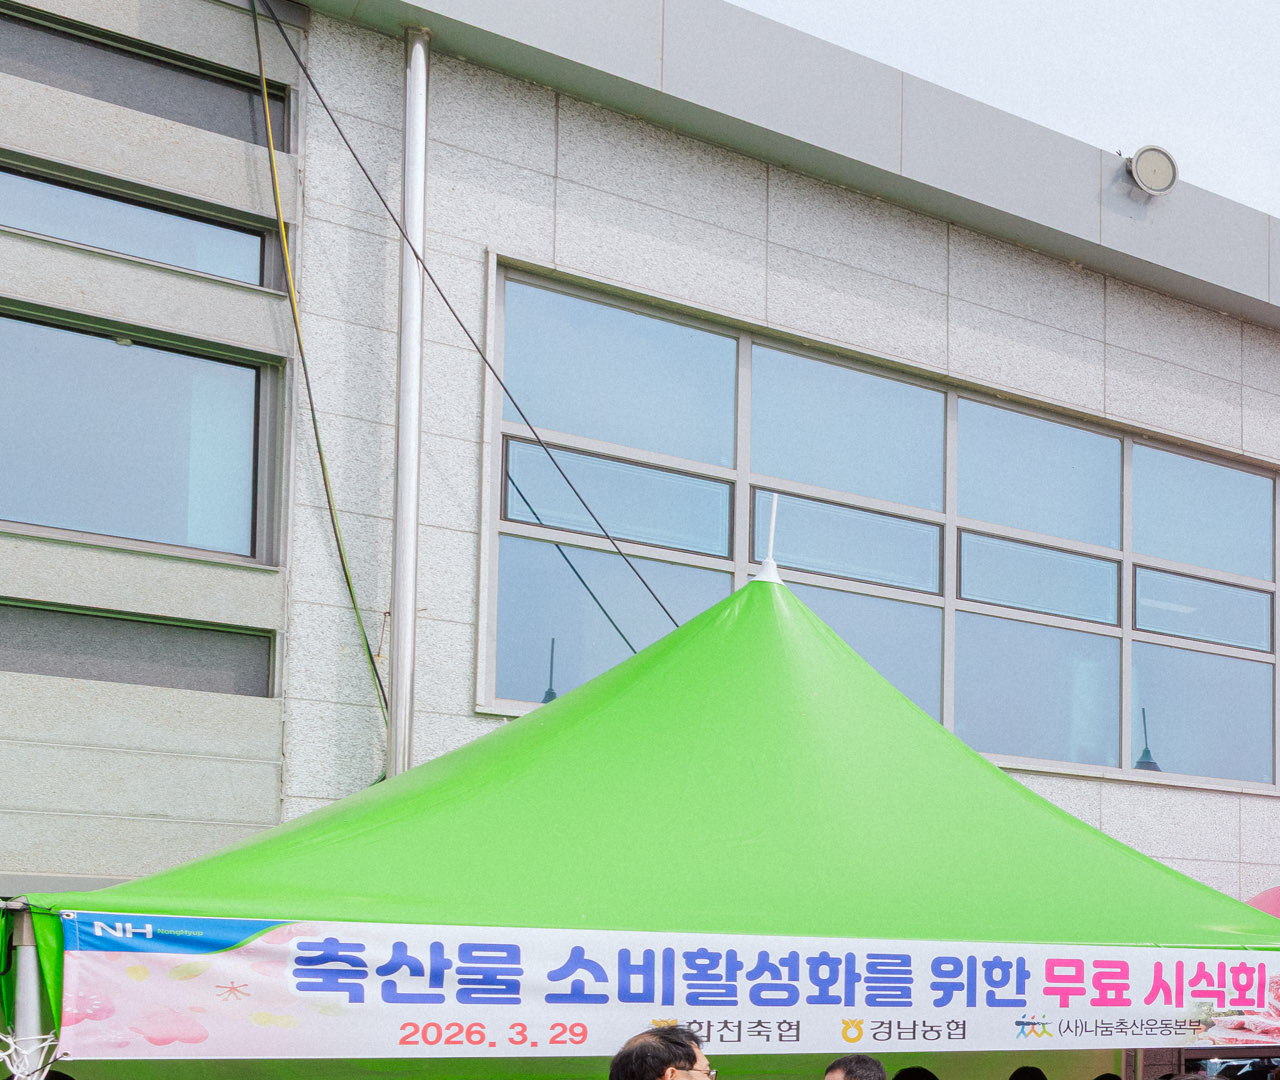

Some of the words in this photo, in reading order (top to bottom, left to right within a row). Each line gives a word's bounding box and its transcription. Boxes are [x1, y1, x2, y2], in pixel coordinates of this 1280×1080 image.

[93, 921, 153, 939] NH
[157, 928, 204, 937] NongHyup
[292, 937, 525, 1005] 축산물
[544, 944, 914, 1008] 소비활성화를
[929, 955, 1030, 1008] 위한
[1042, 959, 1131, 1009] 무료
[1142, 960, 1268, 1010] 시식회
[399, 1022, 497, 1048] 2026.
[509, 1022, 538, 1048] 3.
[549, 1022, 589, 1045] 29
[869, 1018, 967, 1042] 경남농협
[1058, 1018, 1202, 1039] (사)나눔축산운동본부
